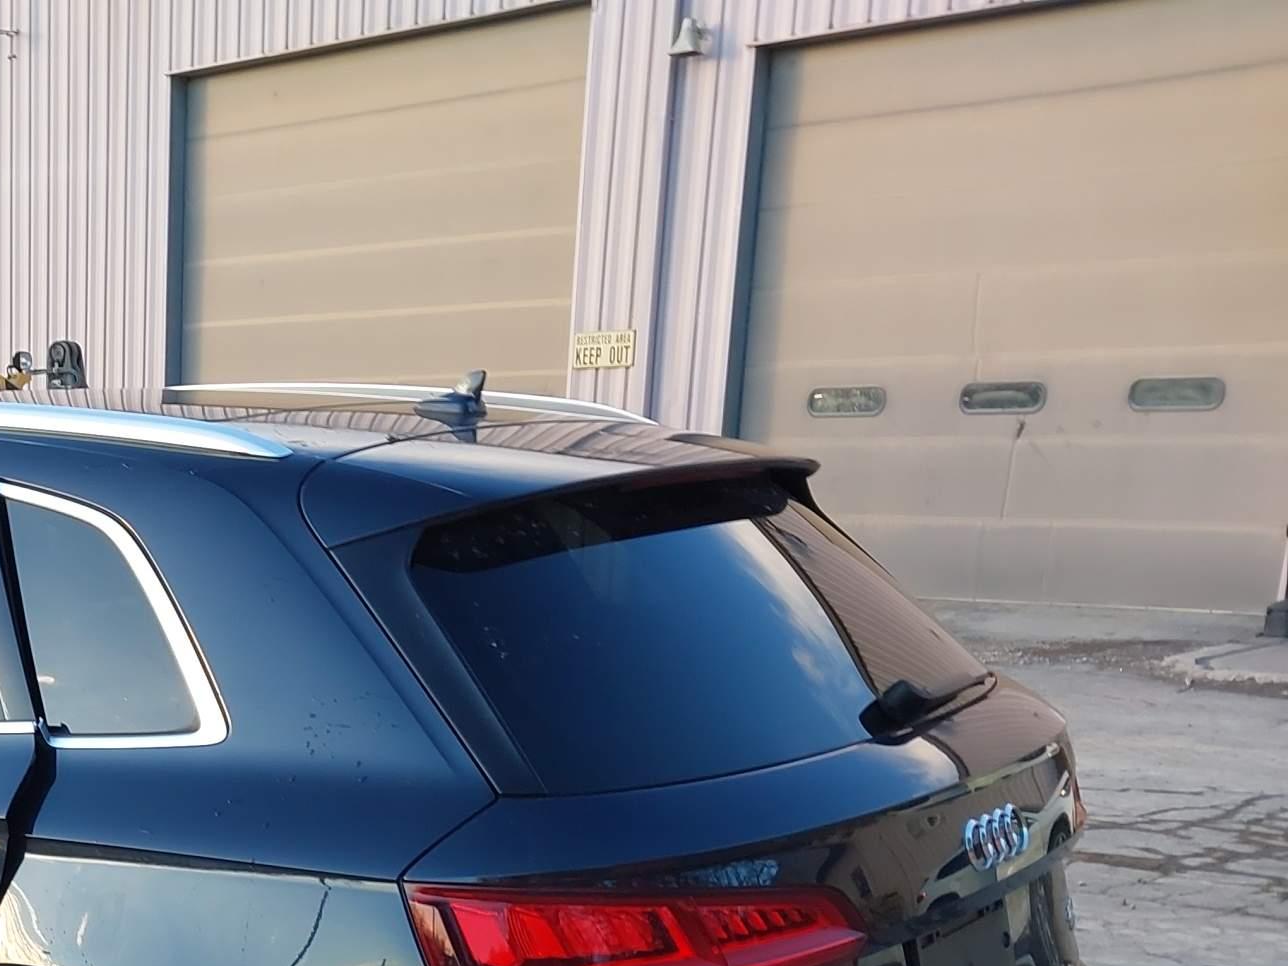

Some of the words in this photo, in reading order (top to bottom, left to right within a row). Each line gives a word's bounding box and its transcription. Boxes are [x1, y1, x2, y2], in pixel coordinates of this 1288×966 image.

[577, 335, 612, 345] RESTRICTED
[616, 333, 631, 343] AREA
[575, 346, 602, 365] KEEP
[609, 345, 631, 364] OUT
